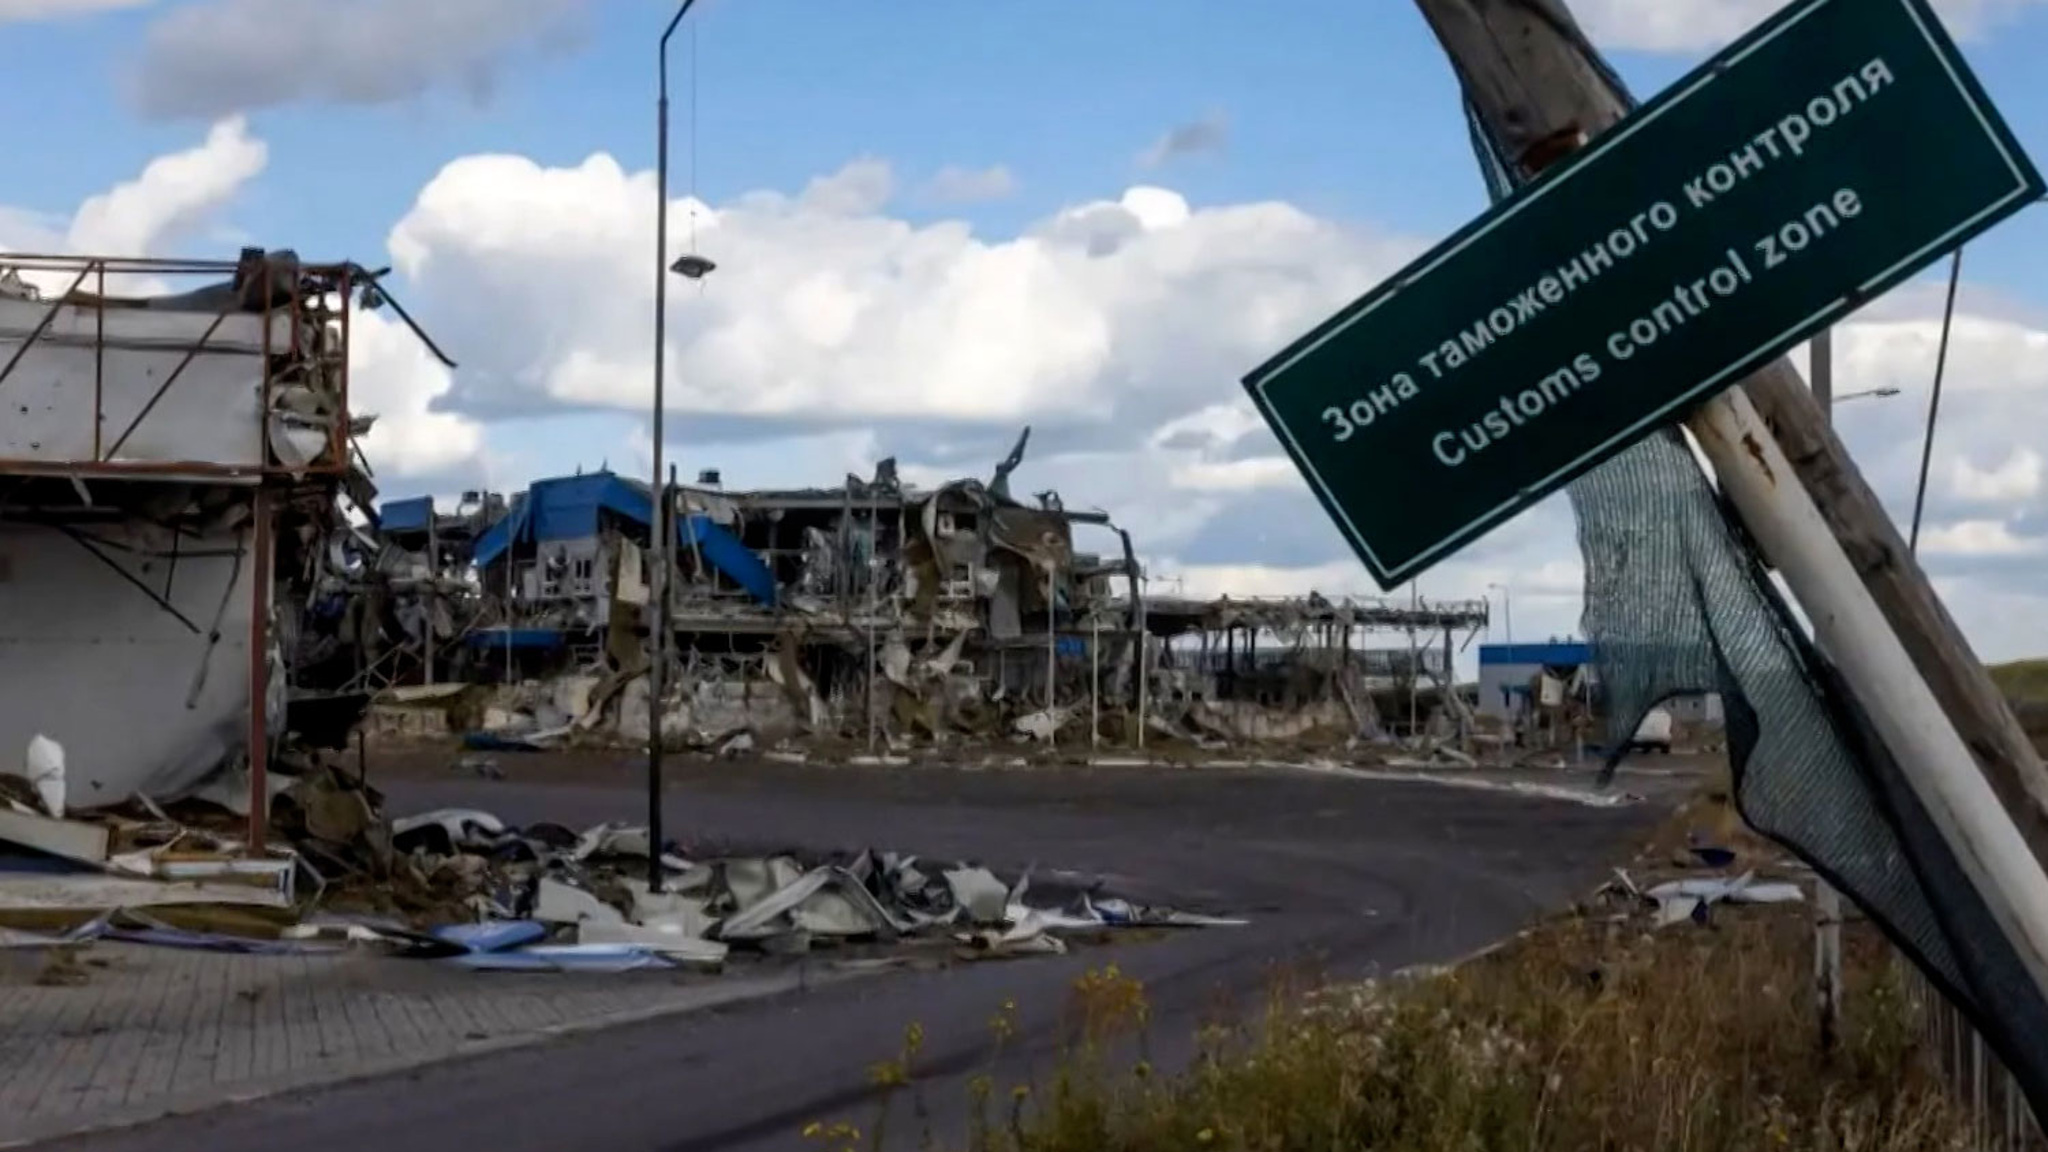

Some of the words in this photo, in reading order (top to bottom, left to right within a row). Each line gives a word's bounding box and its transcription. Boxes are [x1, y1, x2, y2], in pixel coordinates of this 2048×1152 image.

[1322, 373, 1419, 442] Зона
[1419, 202, 1678, 378] таможенного
[1684, 57, 1894, 208] контроля
[1432, 353, 1601, 467] Customs
[1607, 249, 1752, 360] control
[1755, 189, 1862, 269] zone
